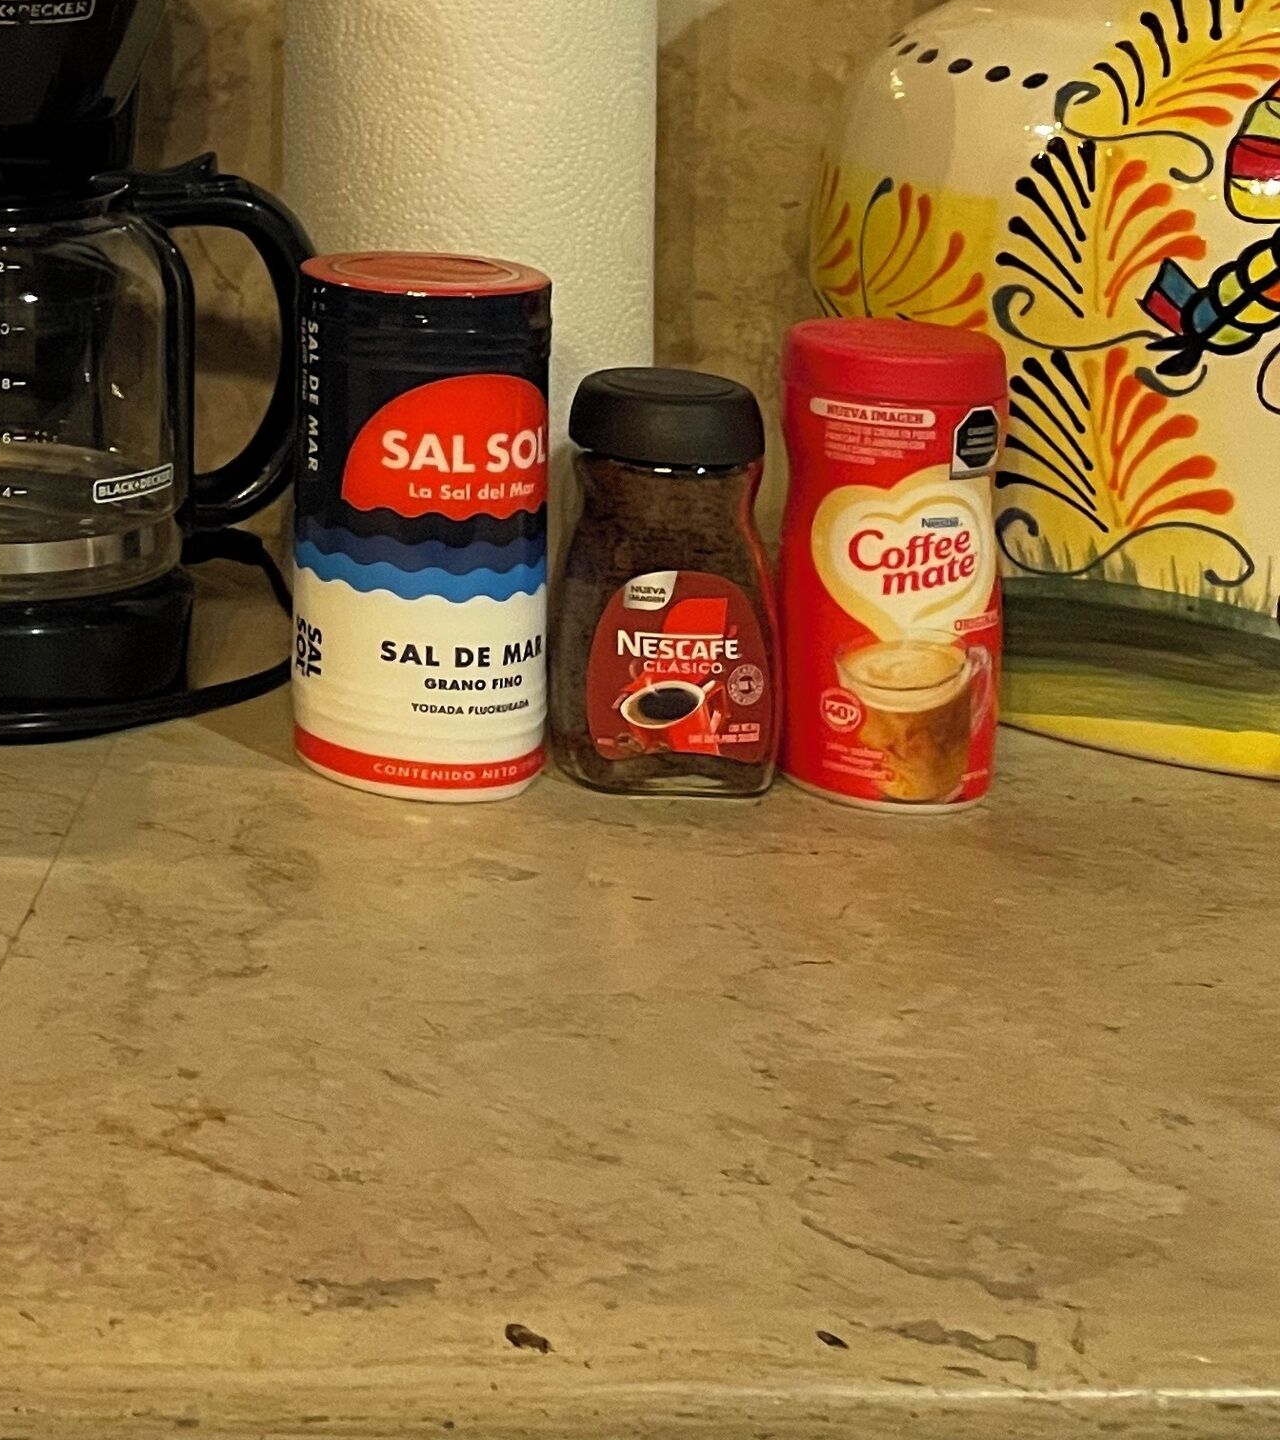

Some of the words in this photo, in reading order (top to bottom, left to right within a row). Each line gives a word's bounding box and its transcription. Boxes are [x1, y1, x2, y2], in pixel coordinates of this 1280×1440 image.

[308, 320, 320, 364] SAL
[2, 378, 10, 390] 8
[309, 375, 320, 406] DE
[826, 404, 869, 422] NUEVA
[2, 433, 11, 444] 6
[308, 414, 319, 471] MAR
[380, 428, 476, 474] SAL
[486, 425, 546, 473] SOL
[2, 487, 11, 498] 4
[408, 482, 432, 499] La
[441, 483, 471, 500] Sal
[477, 482, 505, 500] del
[508, 482, 535, 498] Mar
[848, 528, 972, 571] Coffee
[882, 552, 976, 596] mate
[295, 614, 308, 677] SOL
[307, 623, 322, 678] SAL
[380, 640, 440, 667] SAL
[454, 646, 491, 668] DE
[424, 677, 487, 692] GRANO
[491, 674, 523, 690] FINO
[411, 702, 464, 715] YODADA
[372, 762, 476, 781] CONTENIDO
